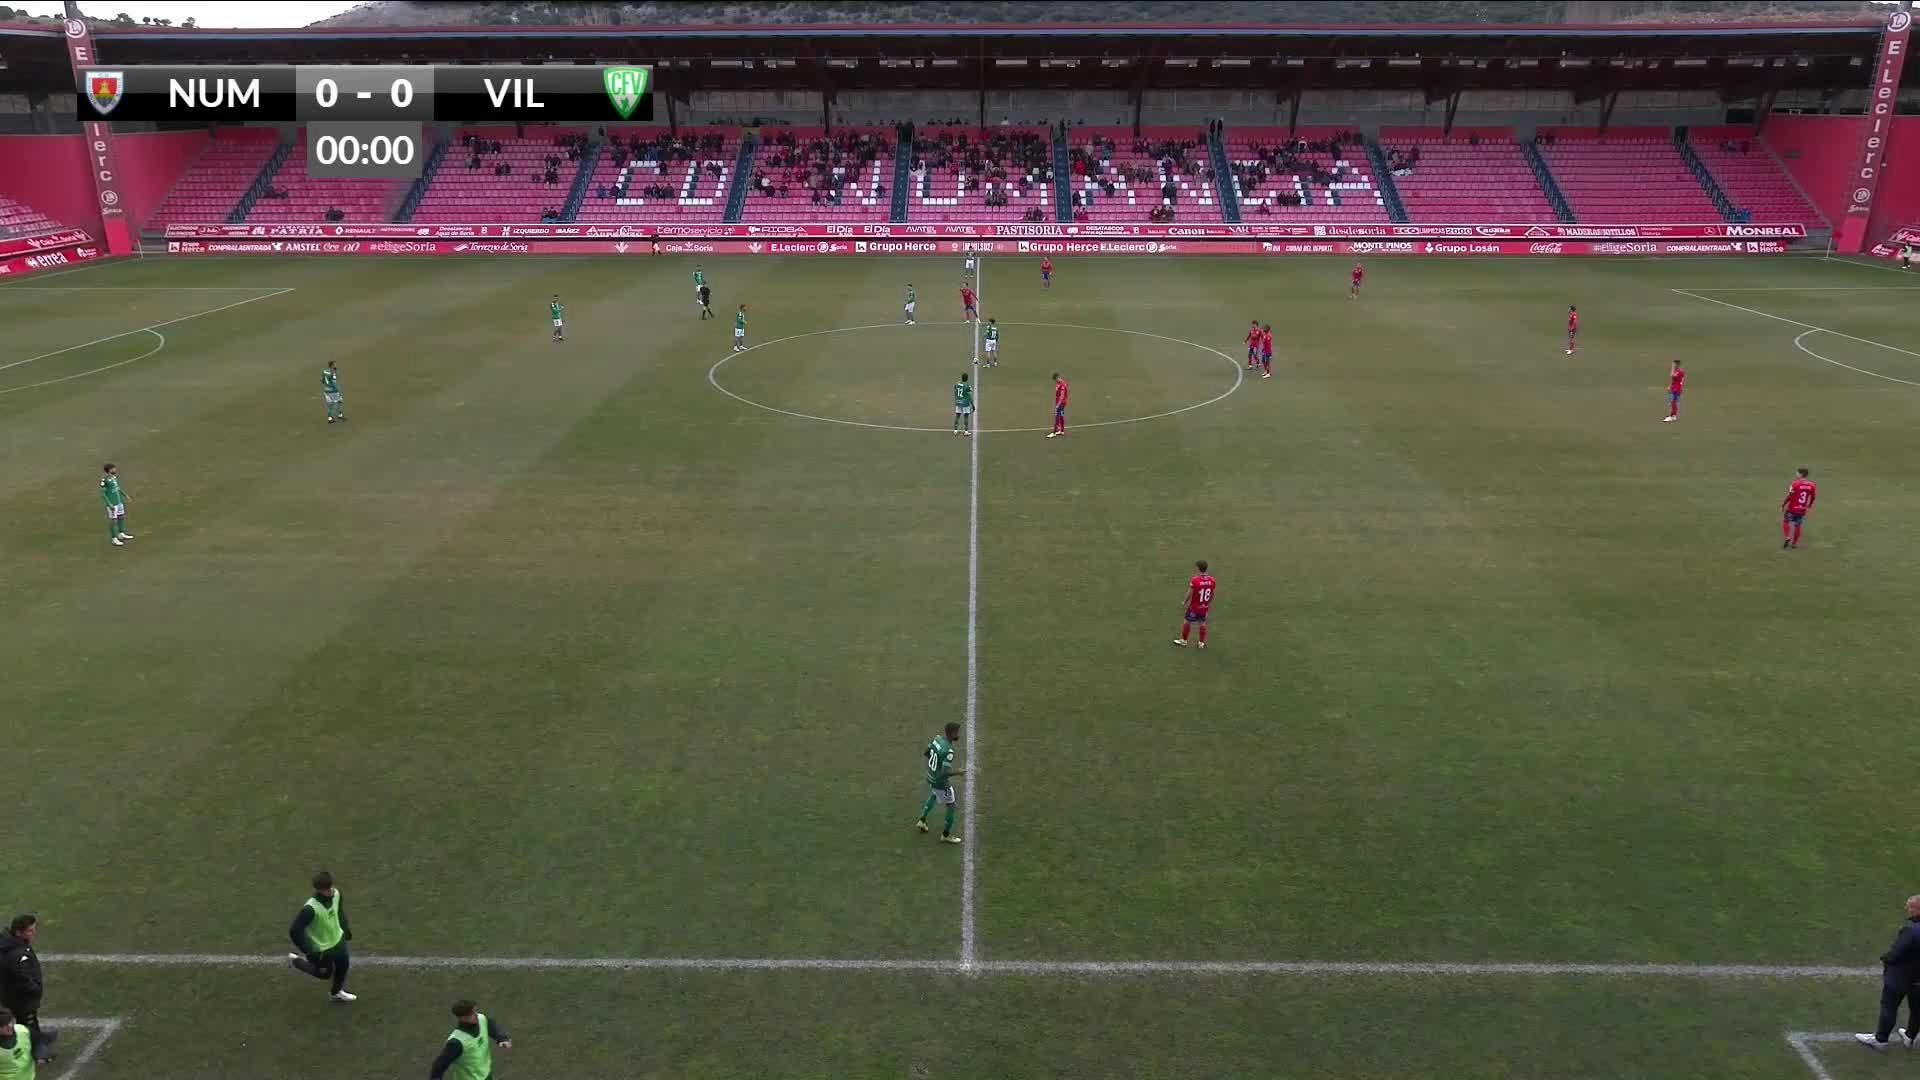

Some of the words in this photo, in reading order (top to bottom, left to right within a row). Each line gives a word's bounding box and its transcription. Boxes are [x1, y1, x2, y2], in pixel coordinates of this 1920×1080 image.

[1860, 40, 1903, 179] E.Leclerc
[657, 225, 723, 235] termoservicio
[996, 225, 1062, 235] PASTISORIA
[1168, 227, 1206, 235] Canon
[1329, 226, 1386, 235] desdesoria
[1726, 226, 1799, 236] MONREAL
[286, 242, 320, 251] AMSTEL
[370, 241, 436, 253] #eligeSoria
[469, 242, 500, 252] Torrezno
[500, 242, 510, 251] de
[510, 242, 528, 252] Soria
[666, 244, 682, 252] Caja
[694, 244, 713, 252] Soria
[771, 243, 815, 251] E.Leclerc
[870, 242, 902, 252] Grupo
[905, 242, 936, 251] Herce
[1030, 242, 1063, 252] Grupo
[1067, 242, 1098, 251] Herce
[1101, 243, 1145, 251] E.Leclerc
[1436, 244, 1467, 253] Grupo
[1470, 243, 1499, 252] Losán
[1593, 243, 1657, 254] #eligeSoria
[1798, 491, 1807, 503] 3
[1198, 588, 1211, 602] 18
[928, 748, 938, 772] 20
